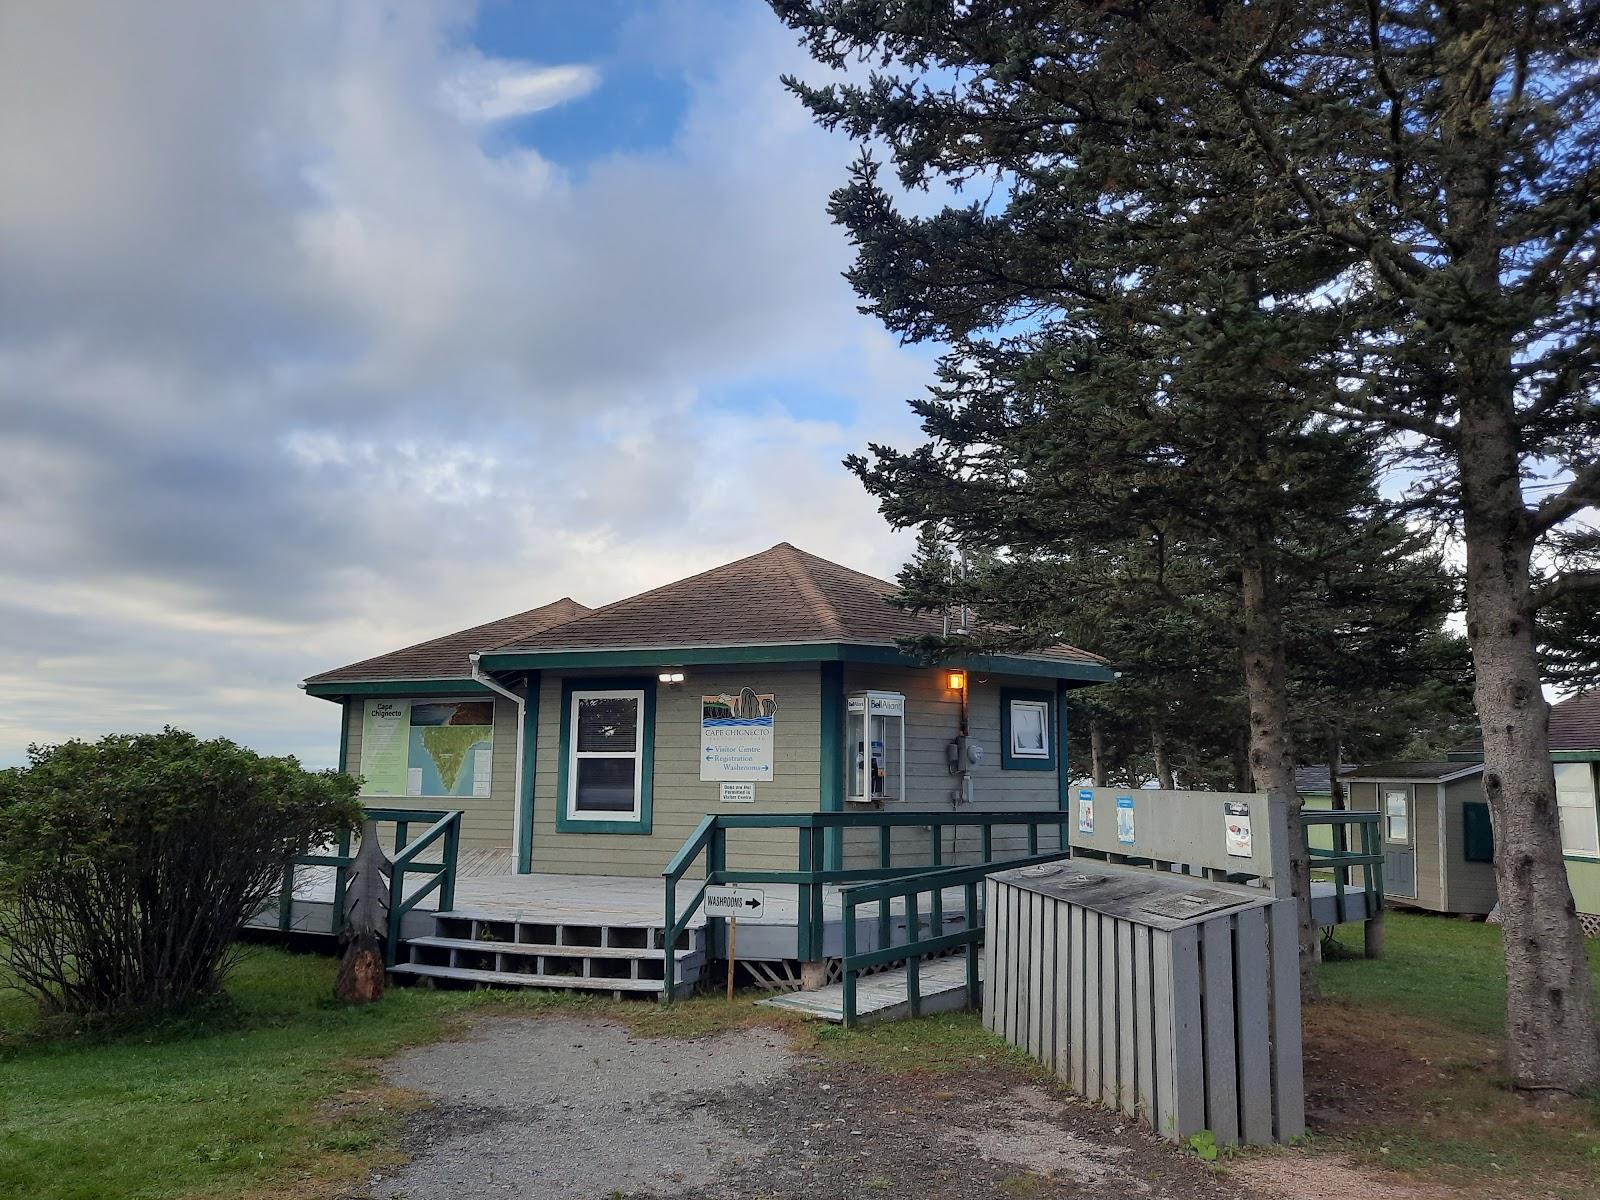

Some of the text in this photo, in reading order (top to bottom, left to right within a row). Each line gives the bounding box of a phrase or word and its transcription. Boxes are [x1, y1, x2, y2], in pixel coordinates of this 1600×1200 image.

[714, 745, 761, 753] Visitor Centre
[714, 754, 753, 763] Registration
[723, 763, 760, 771] Washrooms
[707, 895, 743, 908] WASHROOMS
